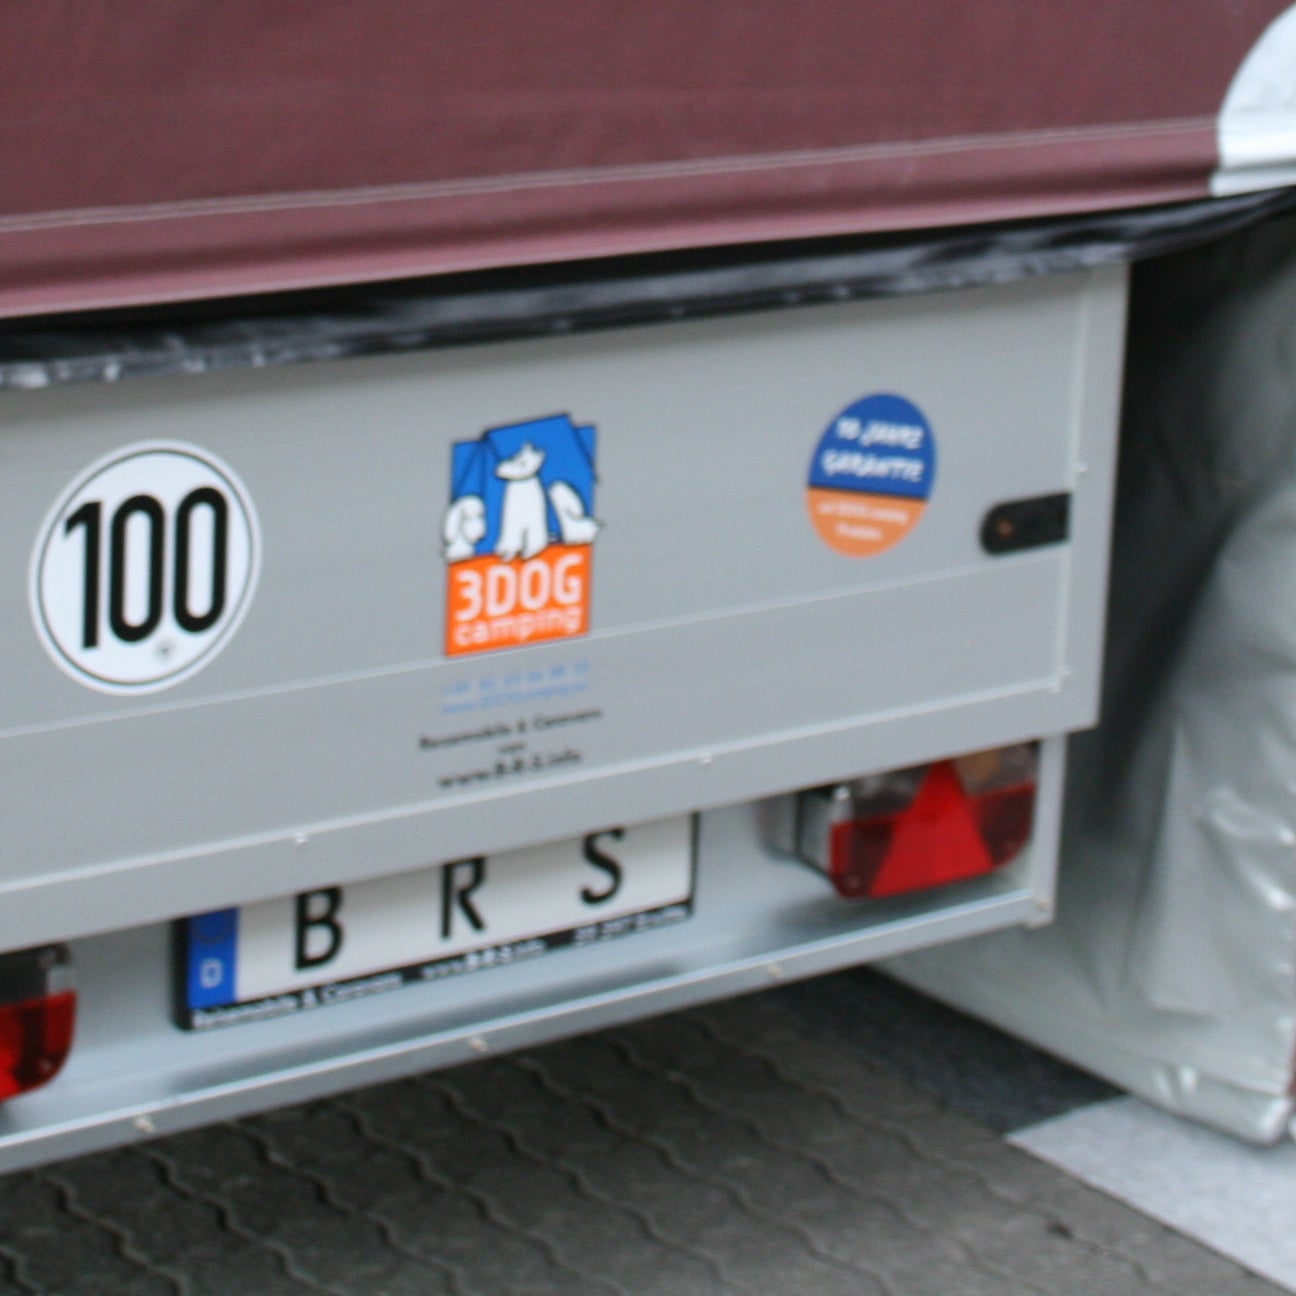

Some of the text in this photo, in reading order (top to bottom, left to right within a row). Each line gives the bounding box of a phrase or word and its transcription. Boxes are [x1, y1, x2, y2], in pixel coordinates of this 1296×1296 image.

[64, 486, 229, 650] 100
[454, 555, 583, 623] 3DOG
[455, 605, 583, 646] camping
[296, 886, 343, 971] B
[440, 856, 486, 939] R
[580, 826, 626, 908] S
